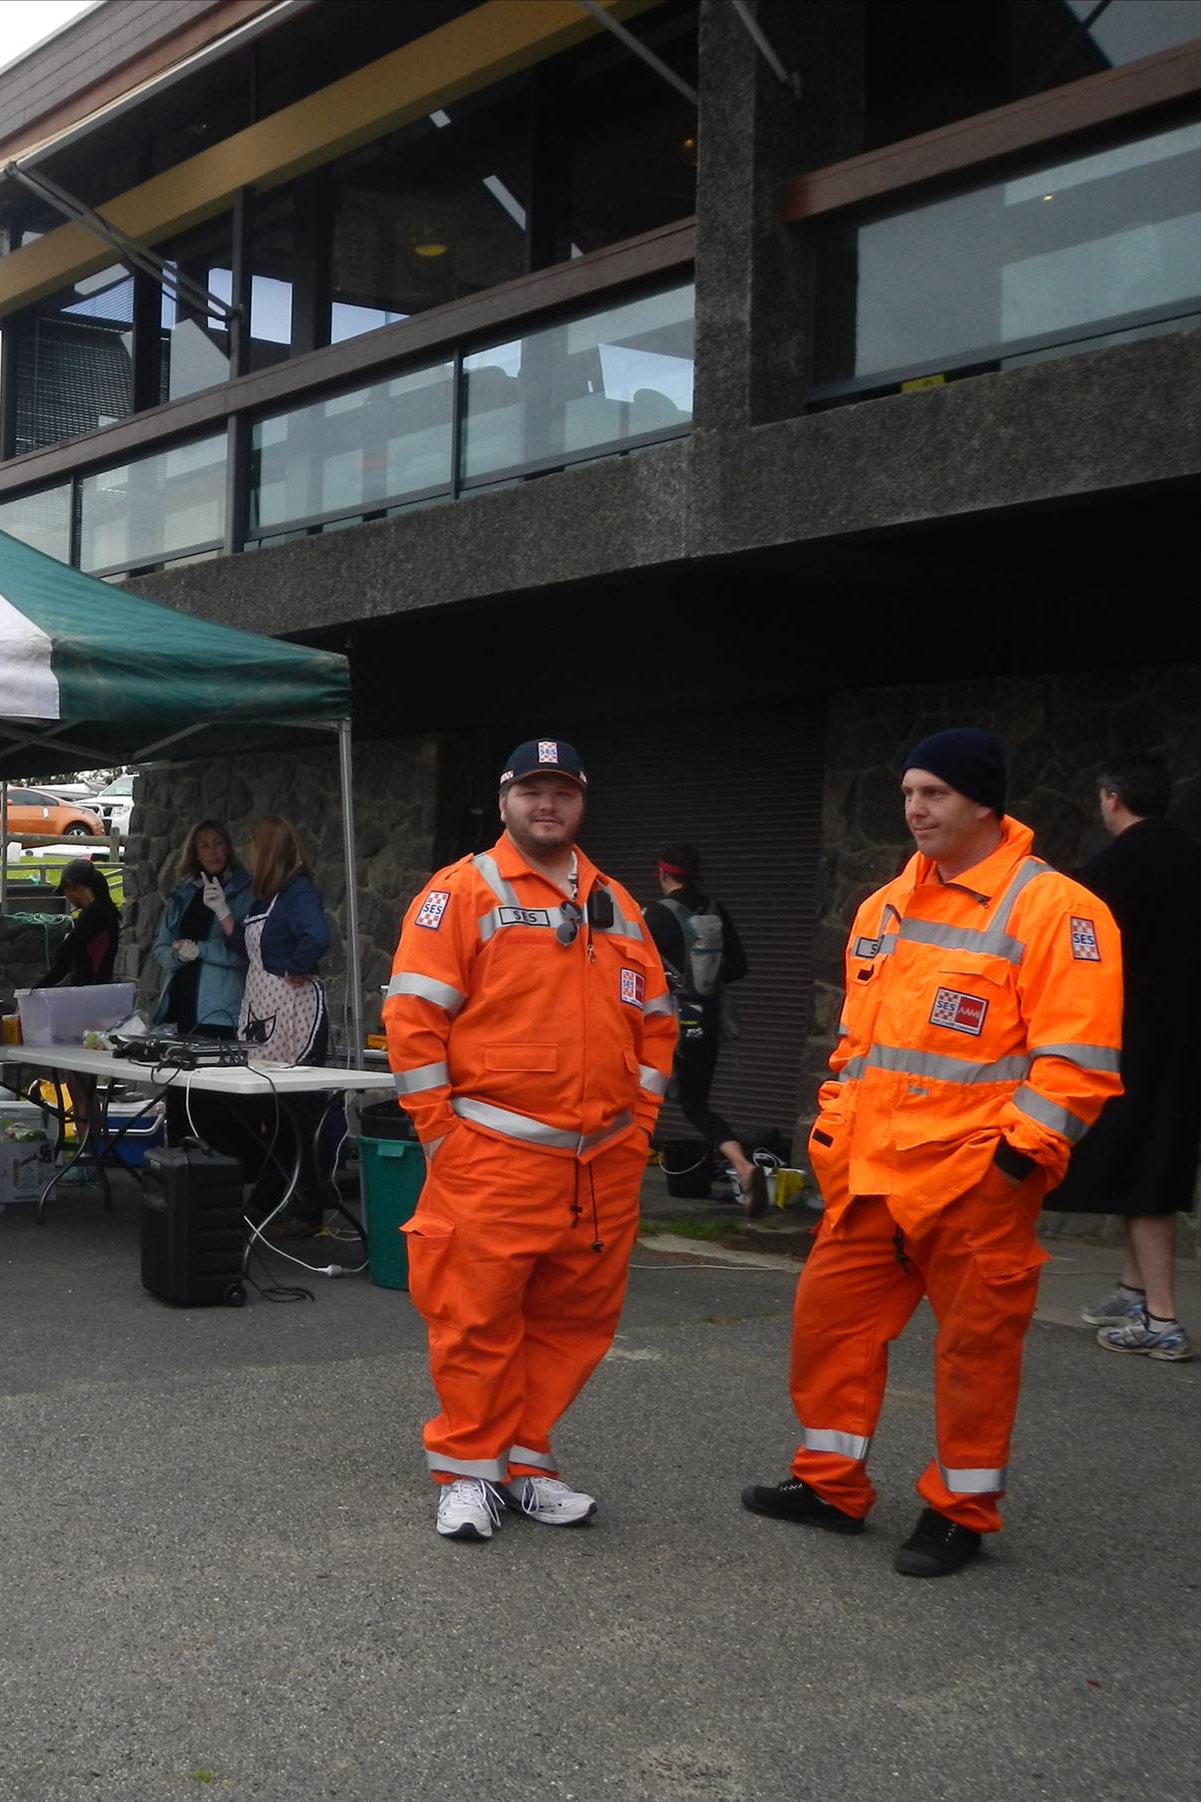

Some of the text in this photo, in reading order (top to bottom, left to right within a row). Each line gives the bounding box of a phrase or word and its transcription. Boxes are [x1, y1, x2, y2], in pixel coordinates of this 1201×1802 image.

[423, 903, 442, 915] SES
[512, 909, 538, 923] SES
[1073, 932, 1095, 945] SES
[936, 1000, 956, 1011] SES
